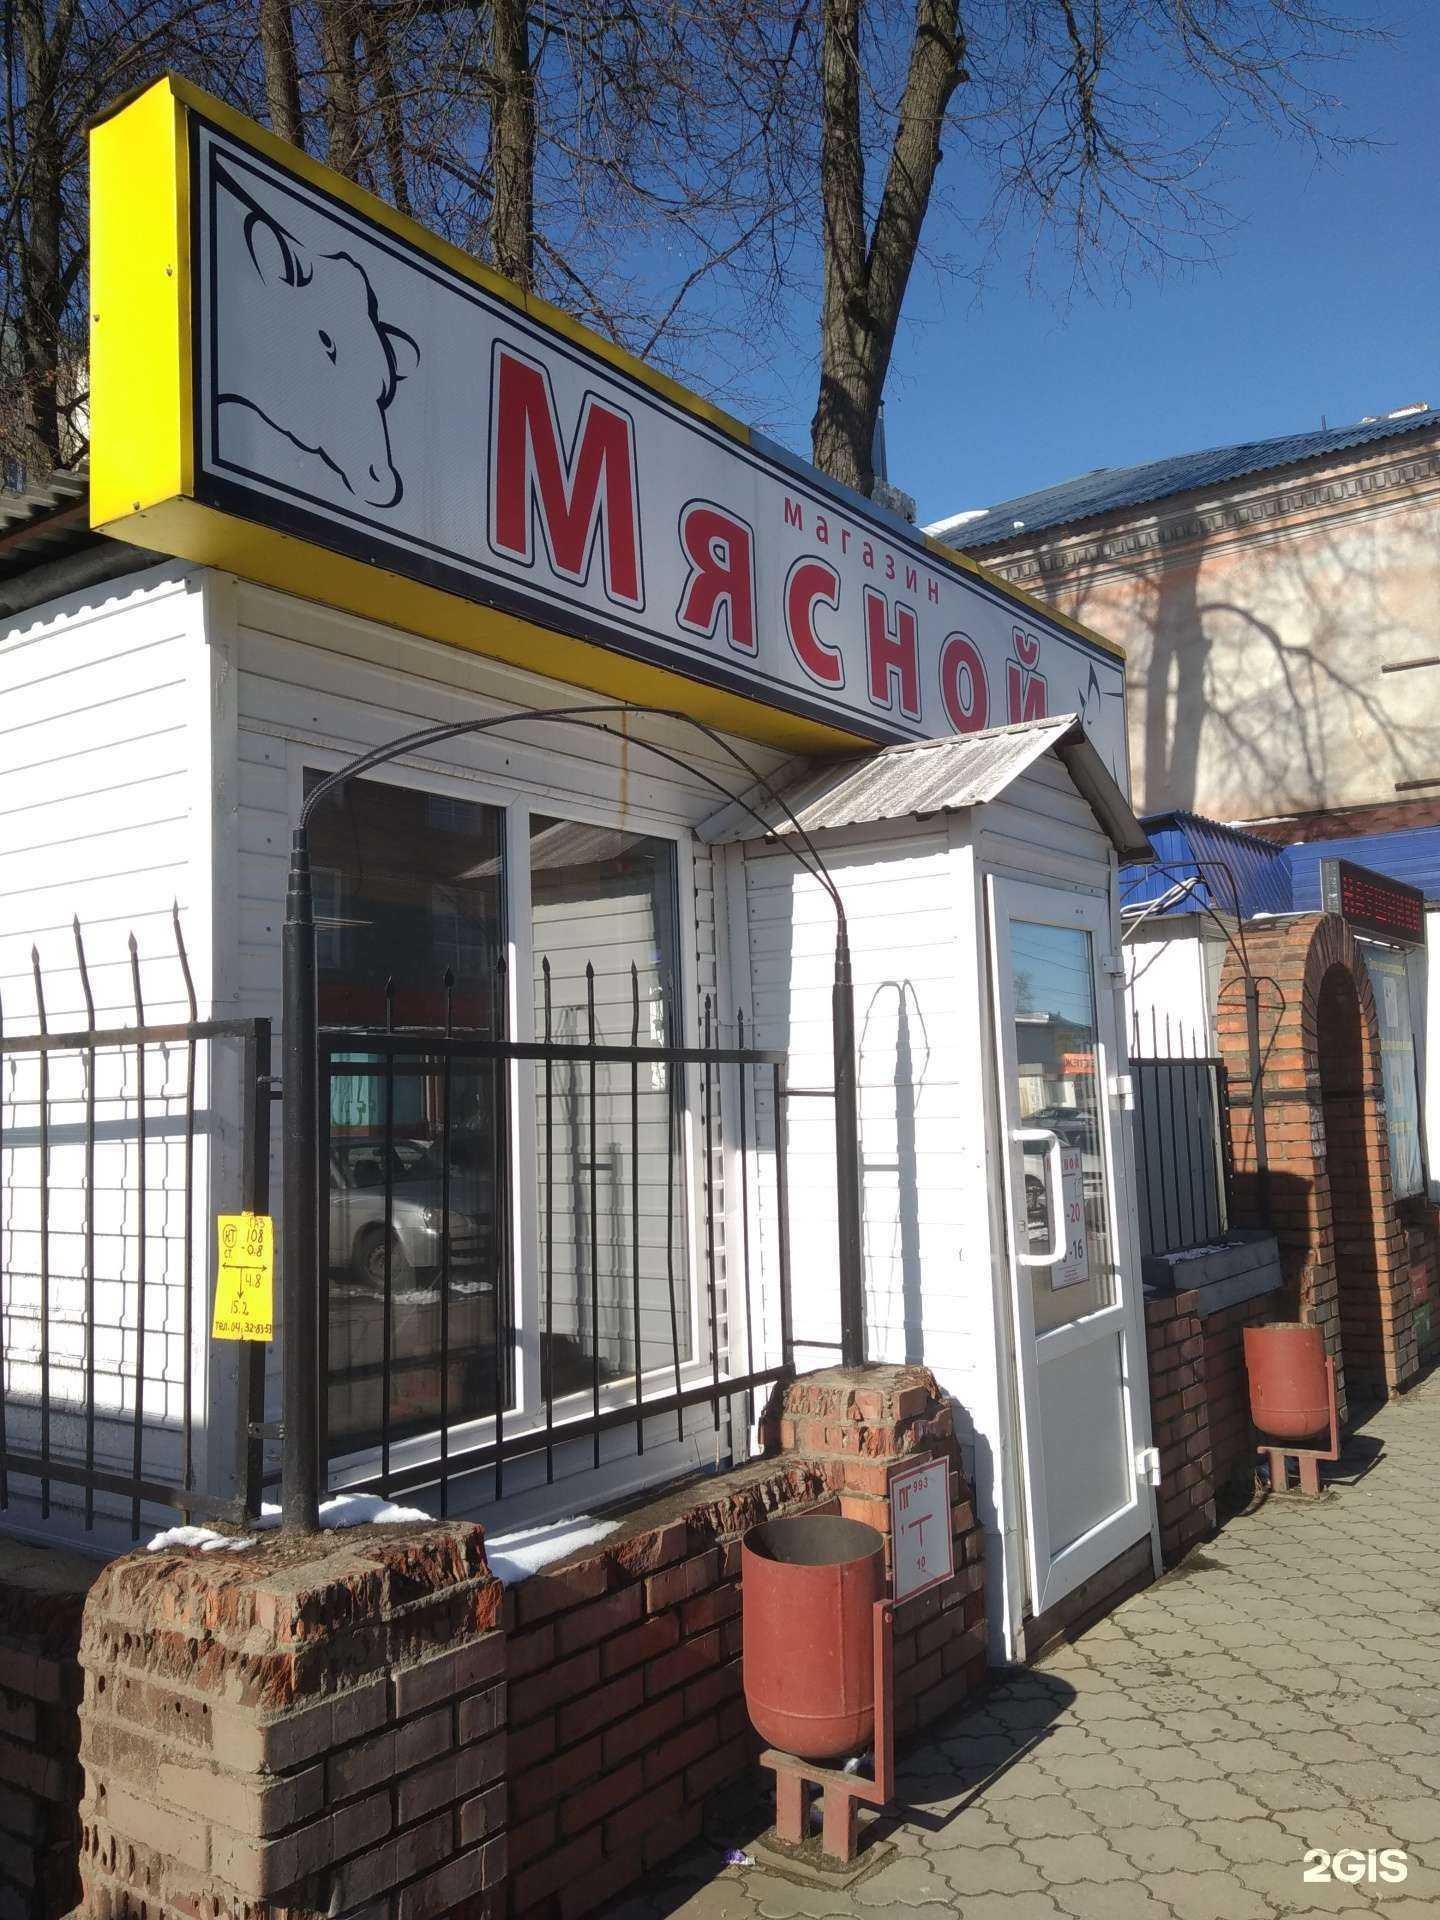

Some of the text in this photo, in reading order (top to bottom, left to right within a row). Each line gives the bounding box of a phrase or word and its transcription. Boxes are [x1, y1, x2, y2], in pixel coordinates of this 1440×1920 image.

[488, 339, 1050, 733] Мясной
[784, 497, 939, 605] магазин
[913, 1476, 929, 1493] 993
